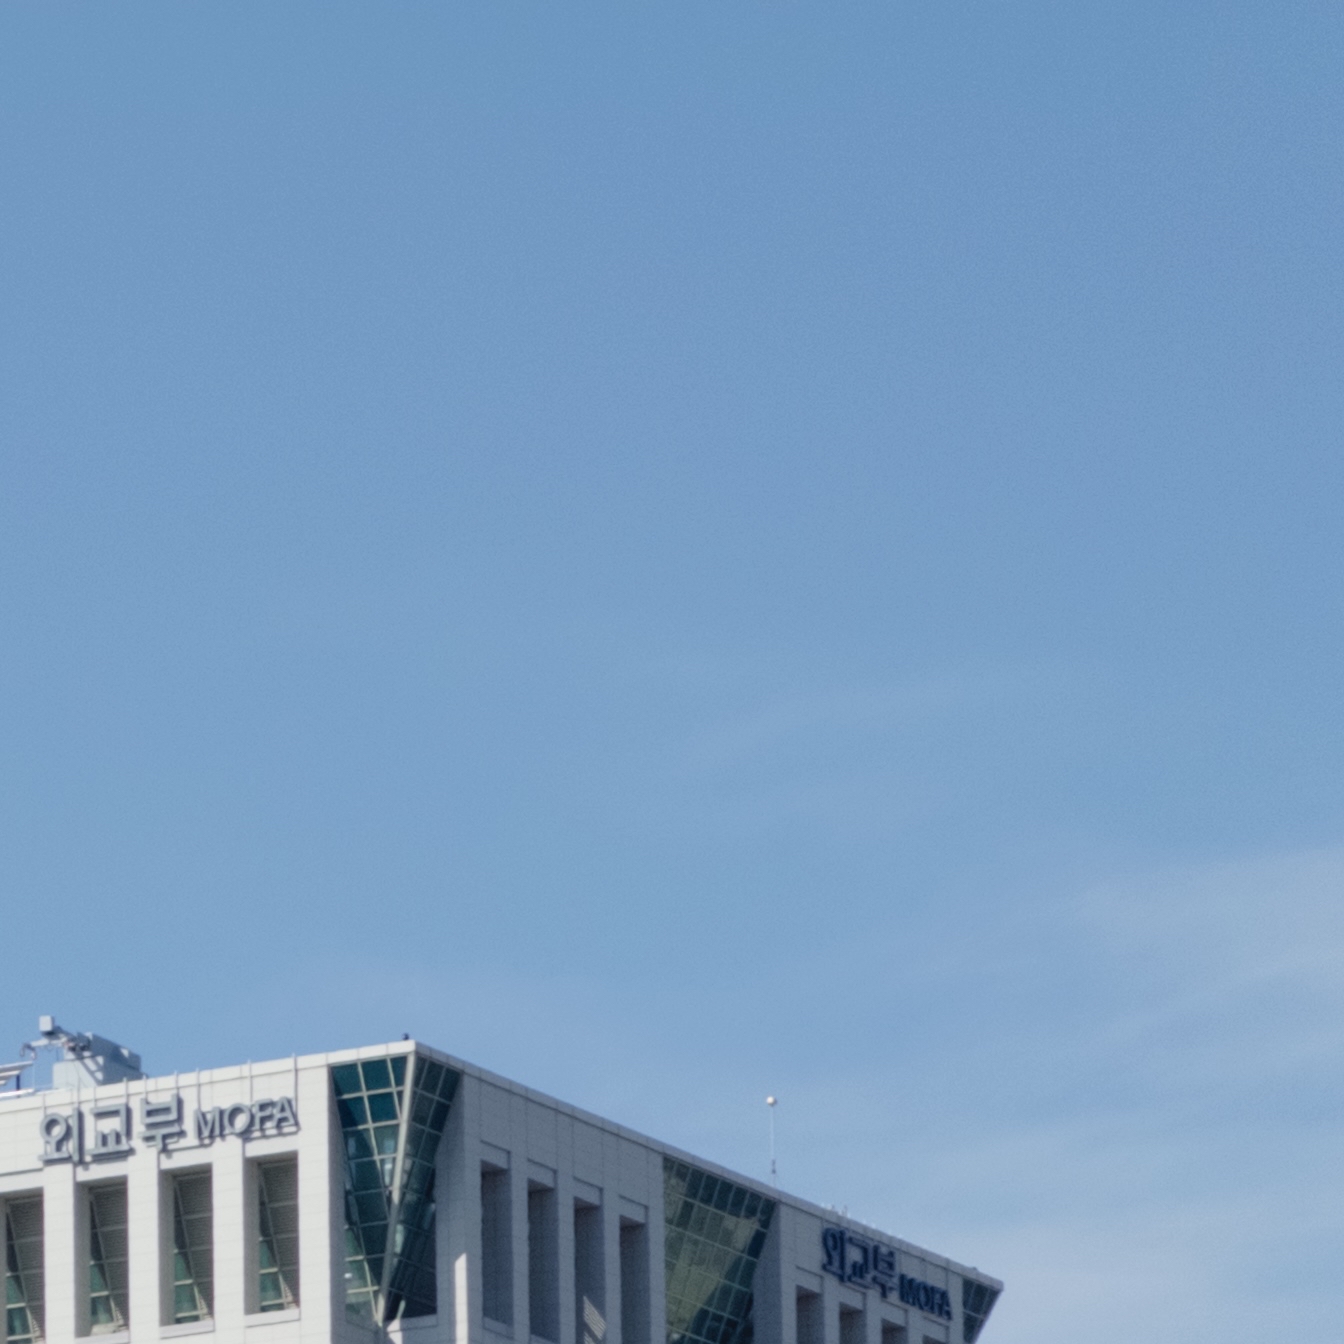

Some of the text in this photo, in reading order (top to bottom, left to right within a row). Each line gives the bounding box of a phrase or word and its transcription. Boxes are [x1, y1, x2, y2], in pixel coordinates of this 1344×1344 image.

[39, 1094, 298, 1164] 외교부 MOFA
[822, 1228, 953, 1321] 외교부 MOFA
